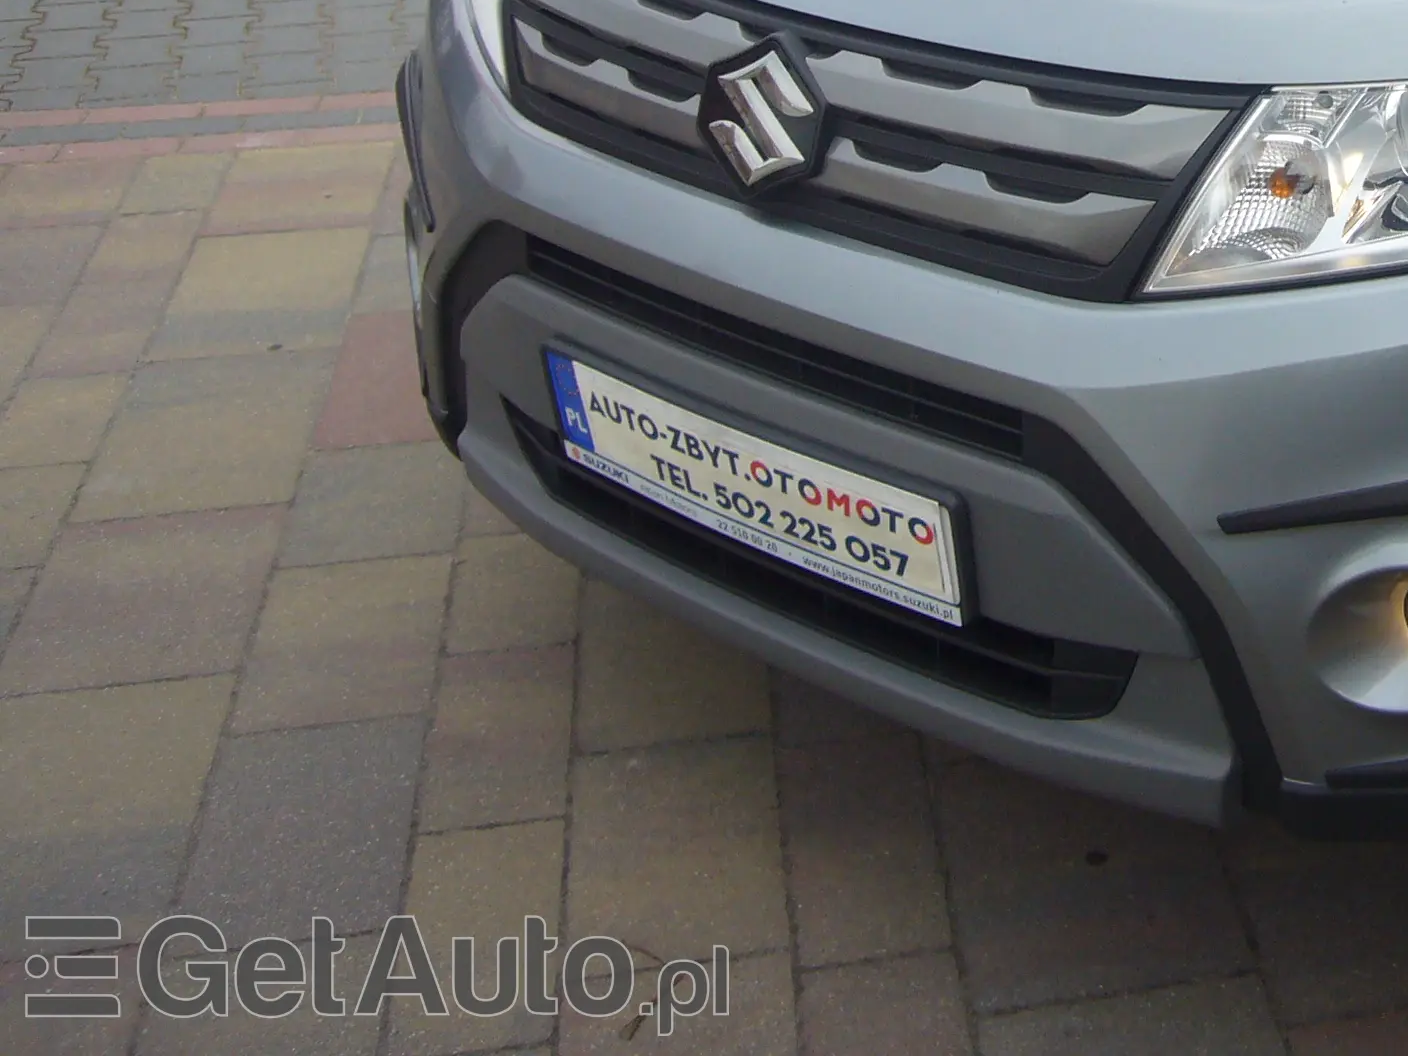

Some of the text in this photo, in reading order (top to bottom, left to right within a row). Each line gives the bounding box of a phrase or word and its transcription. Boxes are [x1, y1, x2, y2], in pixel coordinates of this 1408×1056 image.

[565, 407, 588, 434] PL
[583, 453, 629, 485] SUZUKI
[590, 391, 934, 545] AUTO-ZBYT.OTOMOTO
[650, 454, 708, 501] TEL.
[713, 482, 774, 530] 502
[779, 510, 837, 552] 225
[844, 535, 909, 577] 057
